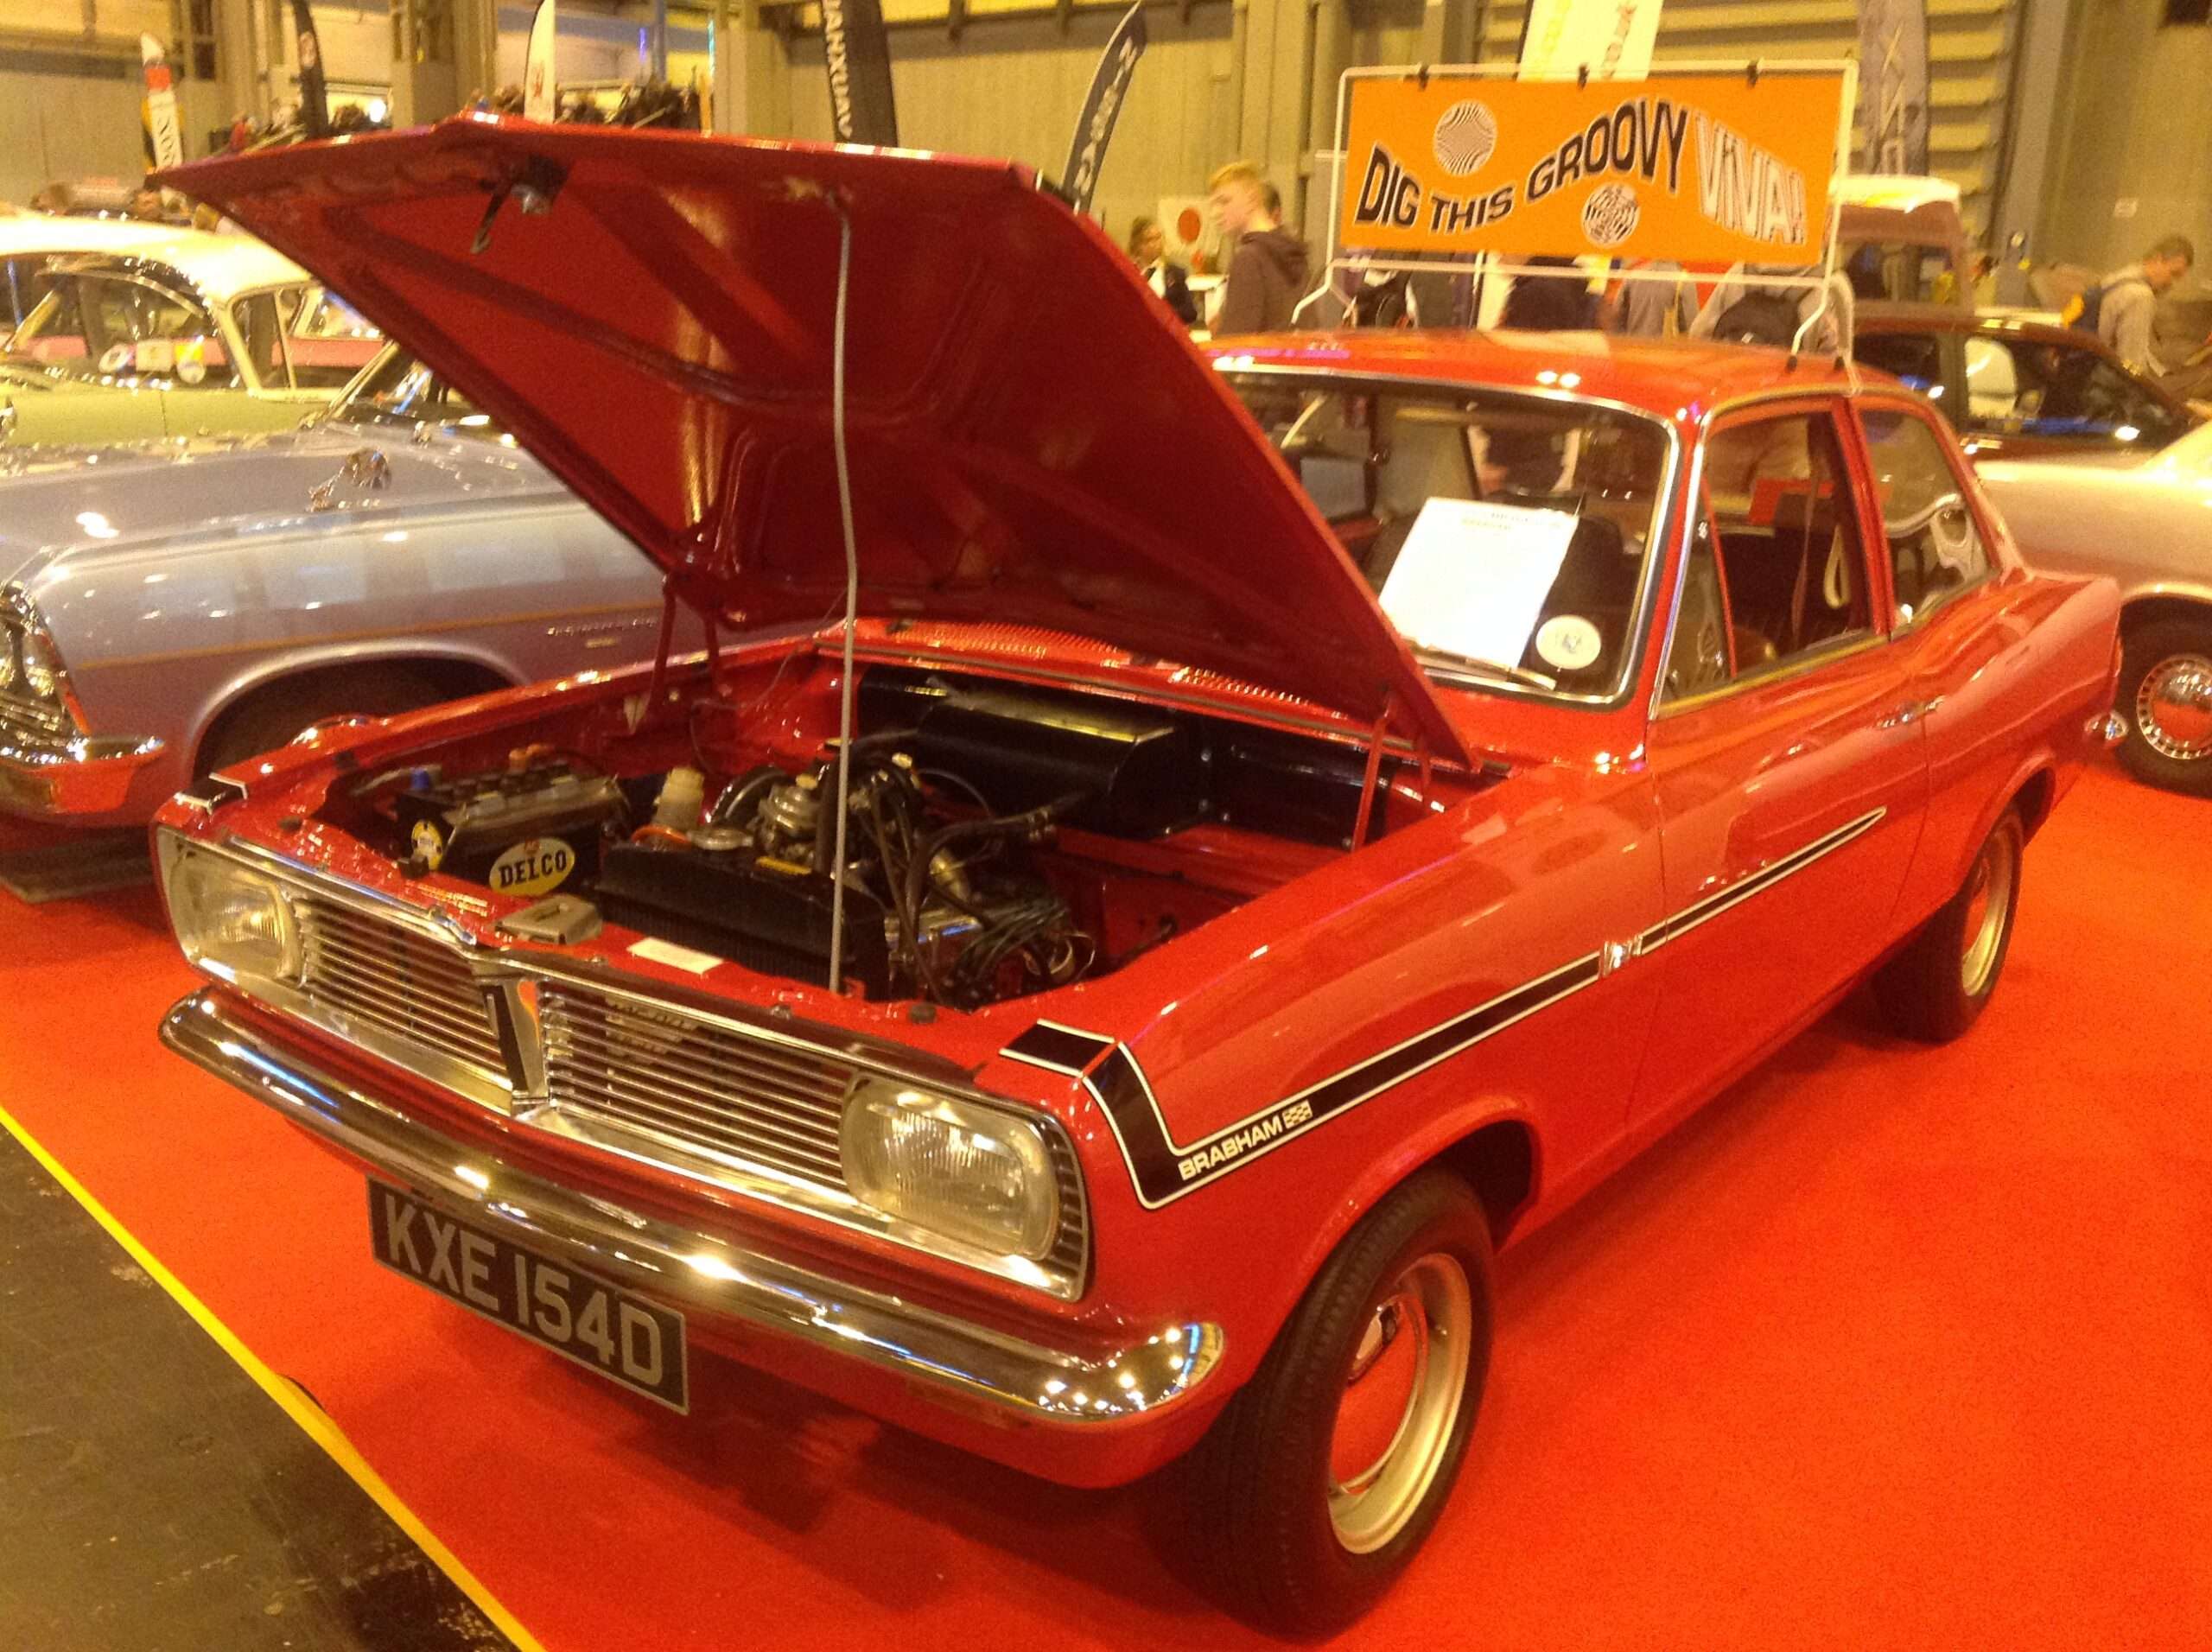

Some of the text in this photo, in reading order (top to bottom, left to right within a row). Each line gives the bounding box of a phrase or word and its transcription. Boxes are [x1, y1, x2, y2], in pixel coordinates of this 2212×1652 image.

[1354, 143, 1422, 228] DIG
[1429, 184, 1516, 234] THIS
[1526, 98, 1689, 201] GROOVY
[499, 849, 567, 888] DELCO
[1178, 1114, 1284, 1181] BRABHAM
[385, 1193, 664, 1387] KXE 154D
